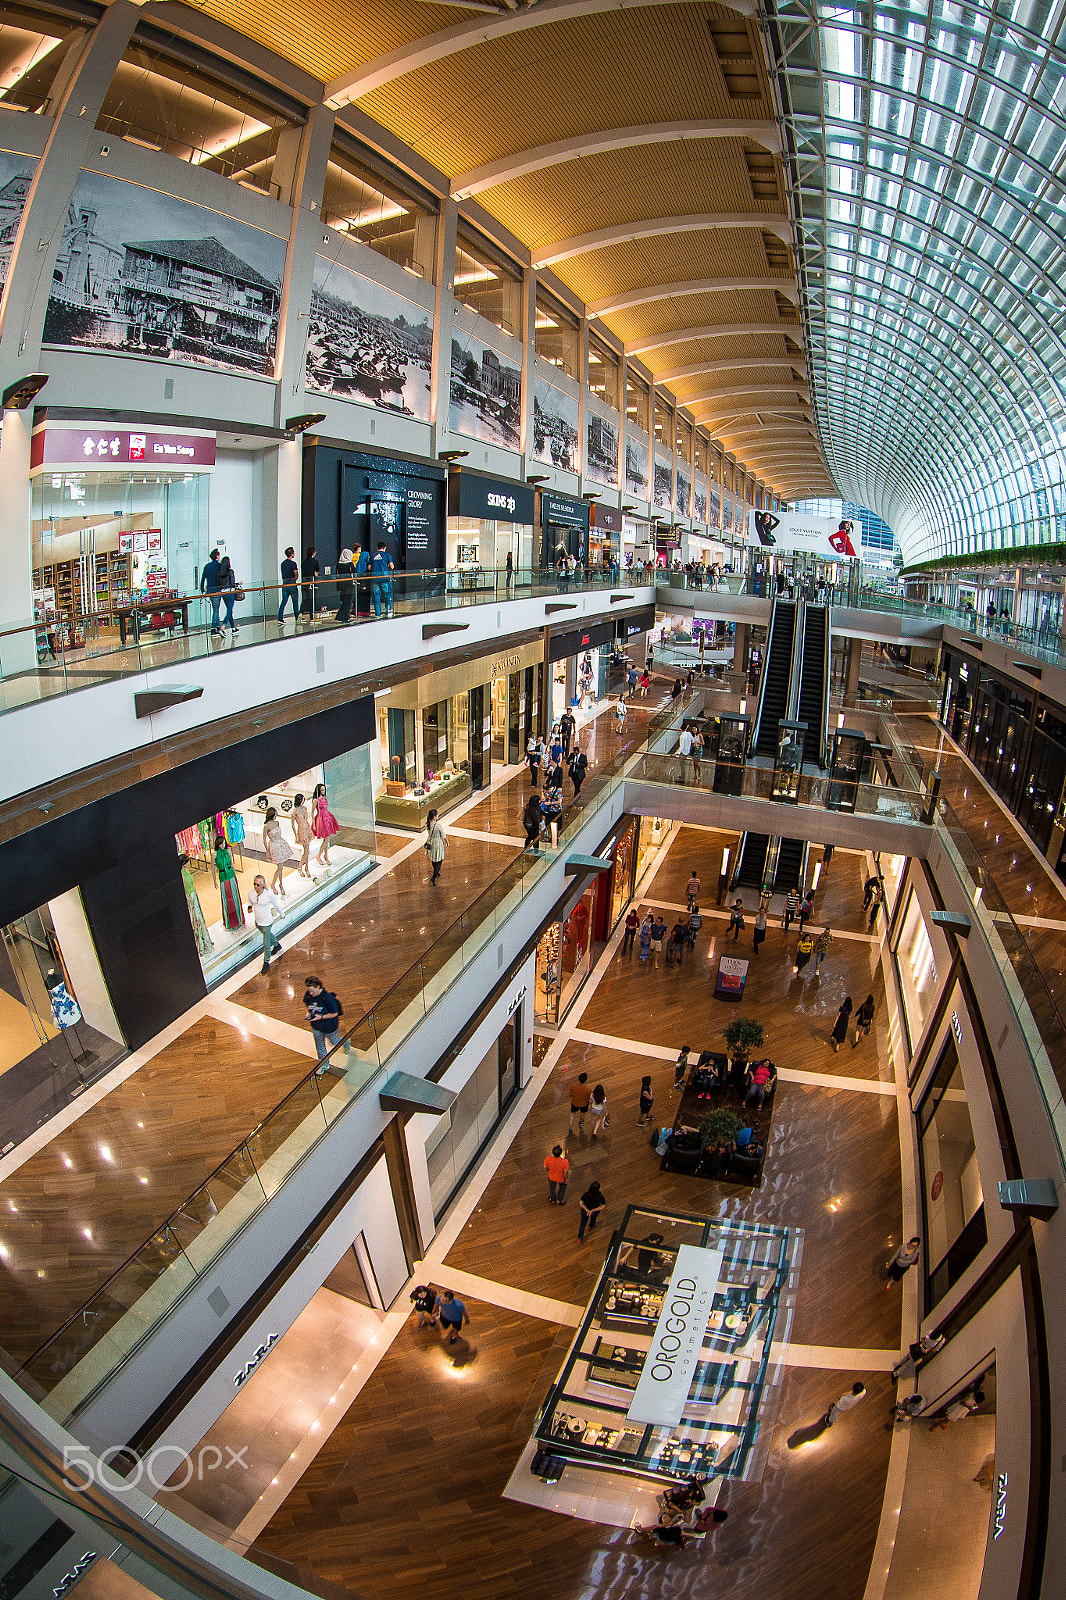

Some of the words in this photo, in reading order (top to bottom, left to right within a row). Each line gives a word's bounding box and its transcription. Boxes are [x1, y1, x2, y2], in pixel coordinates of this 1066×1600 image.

[197, 298, 216, 307] SHIP
[233, 1333, 279, 1387] ZARA
[651, 1278, 697, 1382] OROGOLD
[681, 1290, 708, 1375] cosmetics
